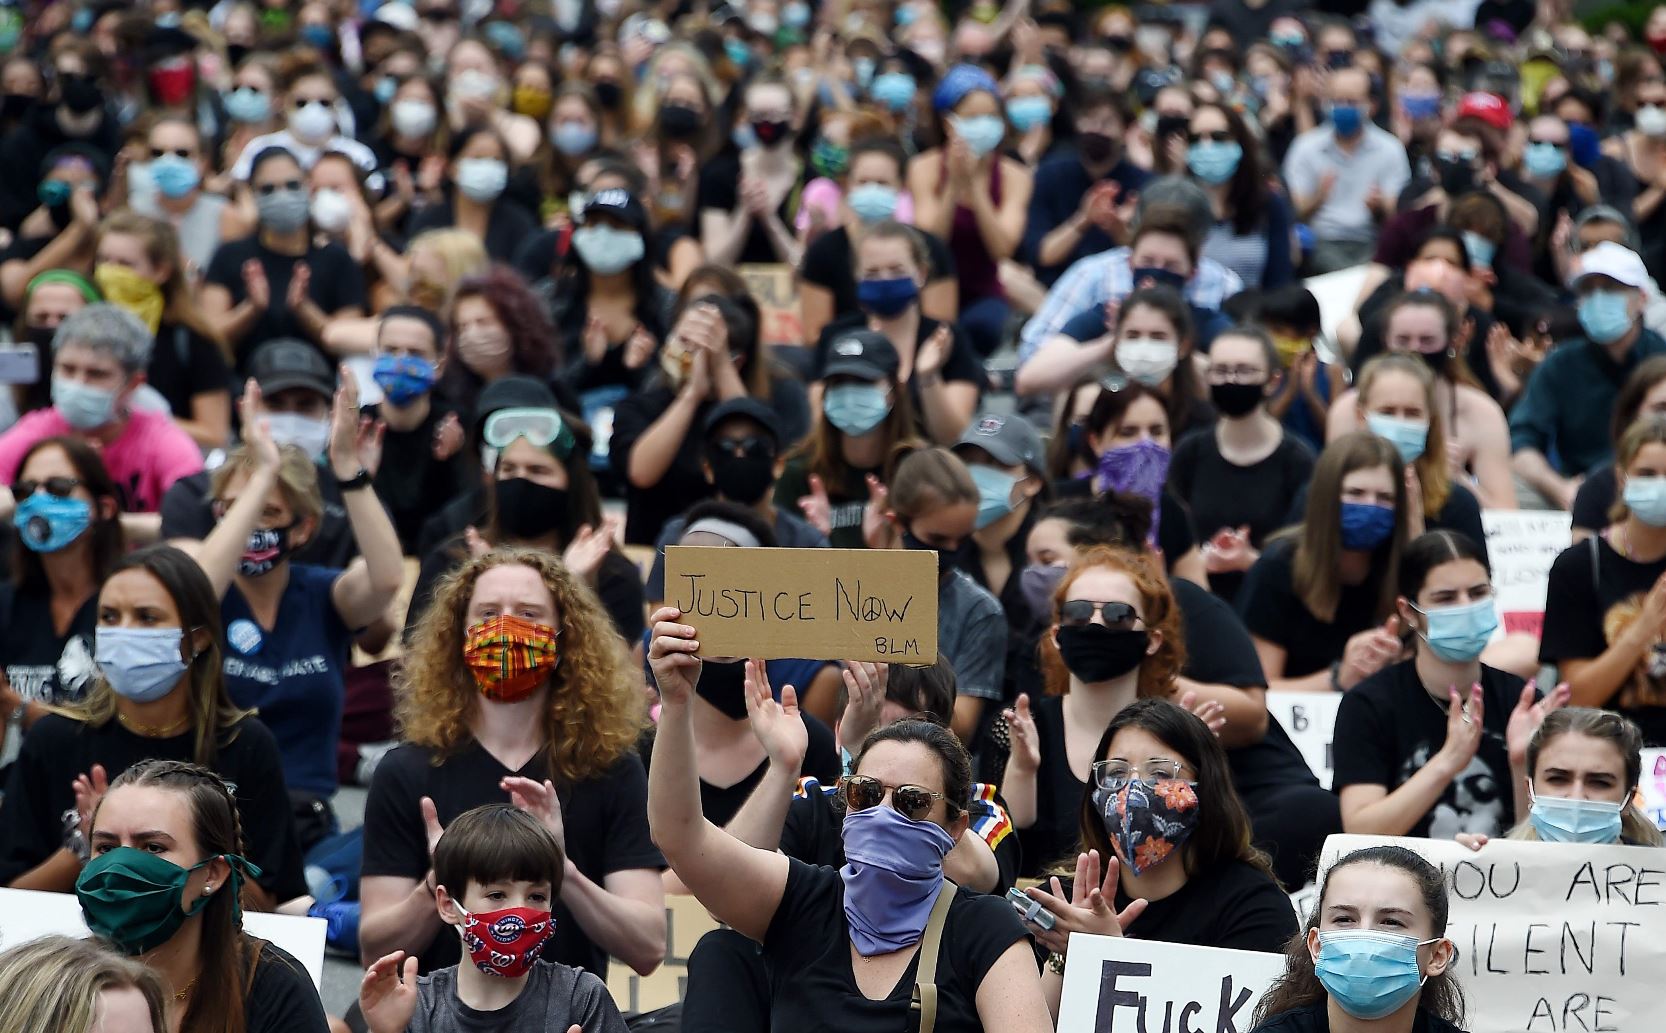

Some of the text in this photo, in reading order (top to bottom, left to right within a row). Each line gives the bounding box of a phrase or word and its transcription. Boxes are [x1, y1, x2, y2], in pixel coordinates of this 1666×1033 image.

[677, 574, 815, 621] JUSTICE
[875, 637, 919, 655] BLM
[1441, 860, 1664, 906] OU ARE
[1527, 993, 1618, 1033] ARE
